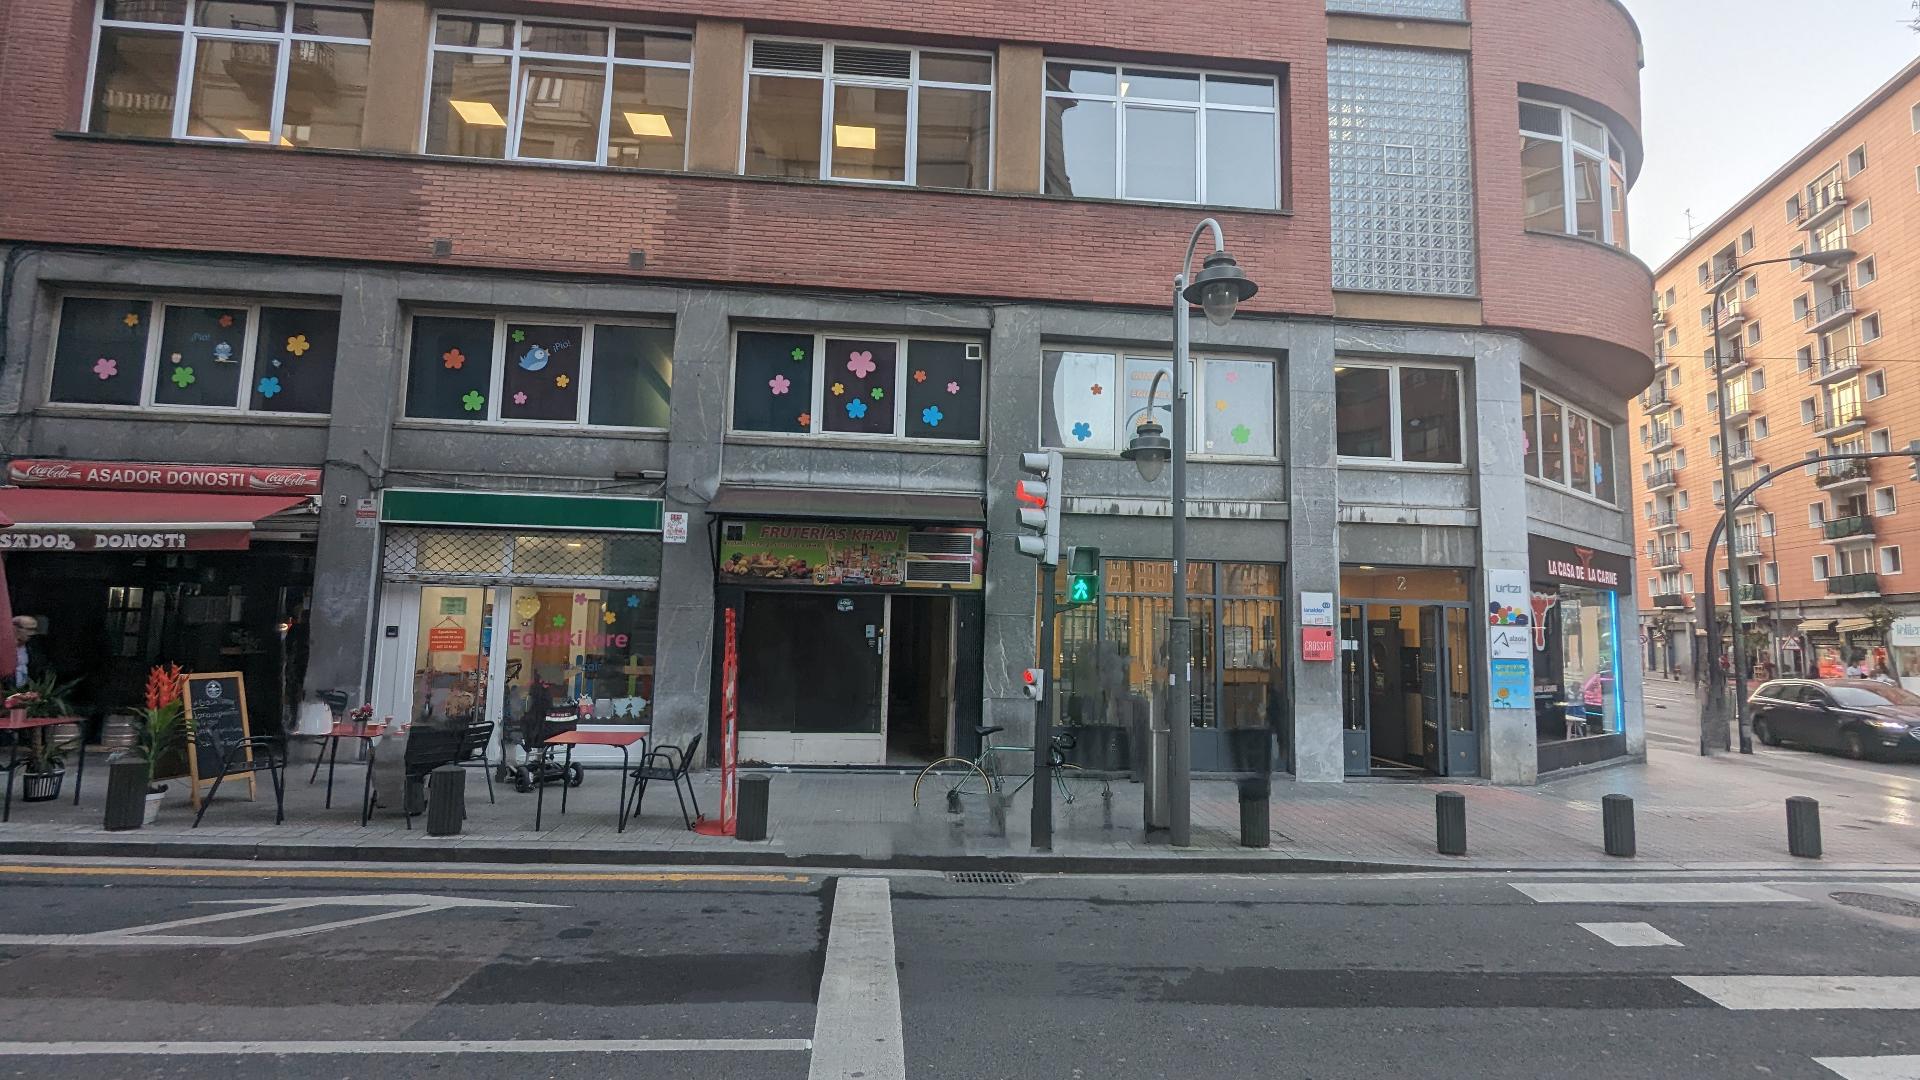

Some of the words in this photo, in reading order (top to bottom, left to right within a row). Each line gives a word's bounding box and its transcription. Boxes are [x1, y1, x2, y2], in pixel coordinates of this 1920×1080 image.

[86, 468, 162, 484] ASADOR
[166, 471, 246, 487] DONOSTI
[851, 528, 900, 542] KHAN
[1548, 559, 1558, 576] LA
[1557, 561, 1576, 579] CASA
[1575, 565, 1585, 580] DE
[1587, 567, 1597, 582] LA
[1596, 569, 1618, 586] CARNE
[1396, 576, 1407, 592] 2
[1495, 584, 1522, 594] urtzi
[1304, 640, 1332, 652] CROSSFIT
